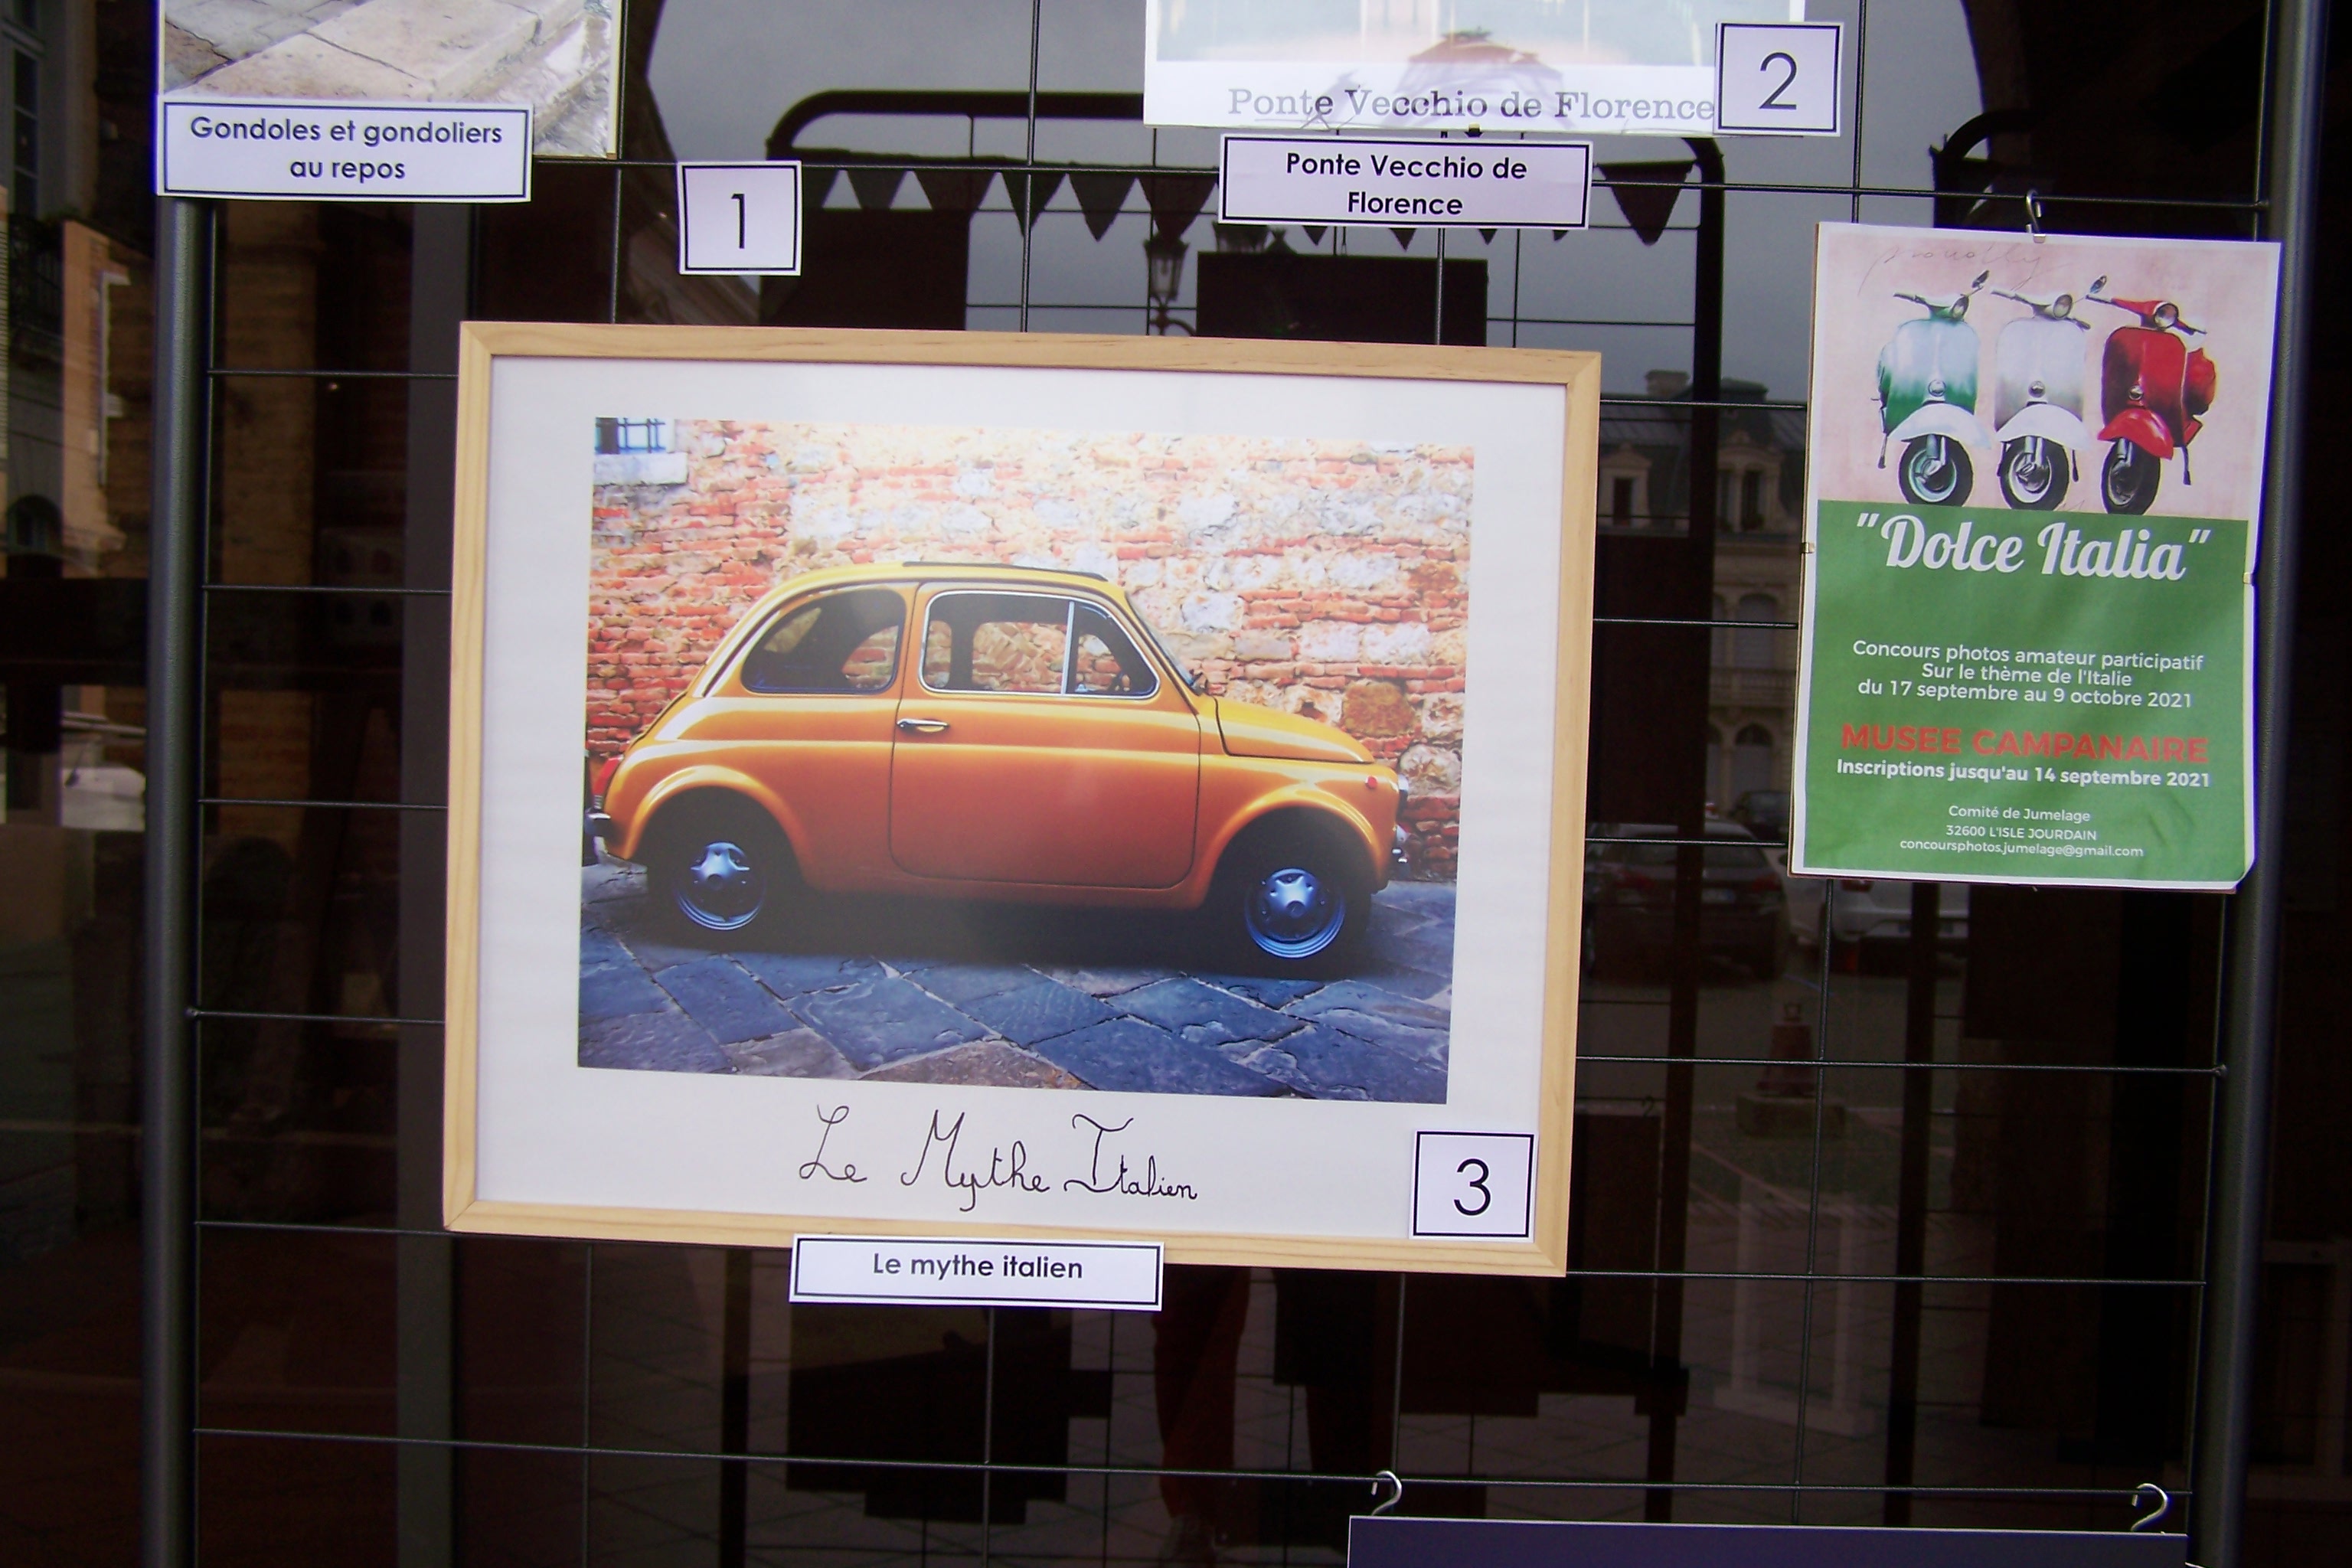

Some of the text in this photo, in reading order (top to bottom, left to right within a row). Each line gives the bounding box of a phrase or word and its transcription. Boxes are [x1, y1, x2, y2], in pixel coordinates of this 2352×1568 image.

[1759, 52, 1798, 110] 2
[1228, 89, 1713, 121] Ponte Vecchio de Florence
[191, 116, 503, 148] Gondoles et gondoliers
[290, 160, 406, 187] au repos
[1286, 152, 1527, 181] Ponte Vecchio de
[1348, 192, 1463, 216] Florence
[731, 193, 746, 250] 1
[1853, 640, 2203, 671] Concours photos amateur participatif
[1922, 663, 2132, 687] Sur le thème de l'Italie
[1858, 678, 2192, 708] du 17 septembre au 9 octobre 2021
[1841, 724, 2209, 763] MUSEE CAMPANAIRE
[1838, 759, 2210, 788] Inscriptions jusqu'au 14 septembre 2021
[1949, 805, 2091, 824] Comité de Jumelage
[1945, 825, 2097, 841] 32600 L'ISLE JOURDAIN
[1900, 839, 2145, 858] concoursphotos.jumelage@gmail.com
[799, 1104, 1197, 1211] Le Mythe Italien
[1452, 1158, 1492, 1216] 3
[873, 1253, 1083, 1281] Le mythe italien
